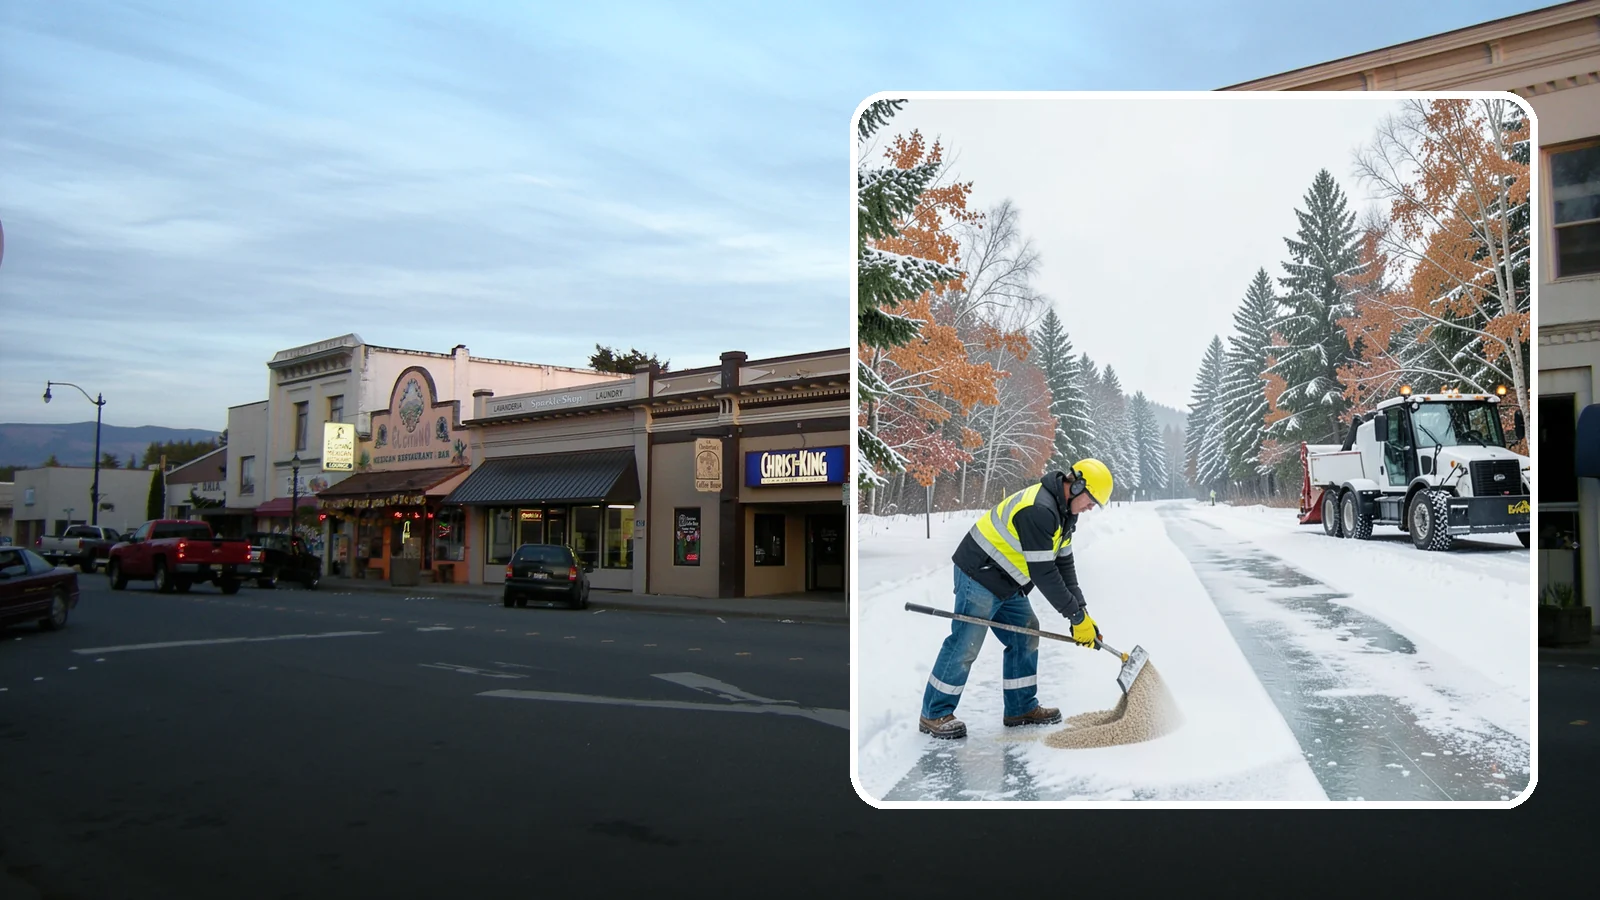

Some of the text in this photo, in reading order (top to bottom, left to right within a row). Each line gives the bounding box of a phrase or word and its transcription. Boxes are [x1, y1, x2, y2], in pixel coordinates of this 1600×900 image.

[595, 389, 624, 400] LAUNDRY
[493, 402, 522, 412] LAVANDERIA
[531, 395, 583, 408] Sparkle Shop
[373, 455, 396, 464] MEXICAN
[397, 451, 433, 462] RESTAURANT
[437, 450, 450, 459] BAR
[799, 450, 828, 477] KING
